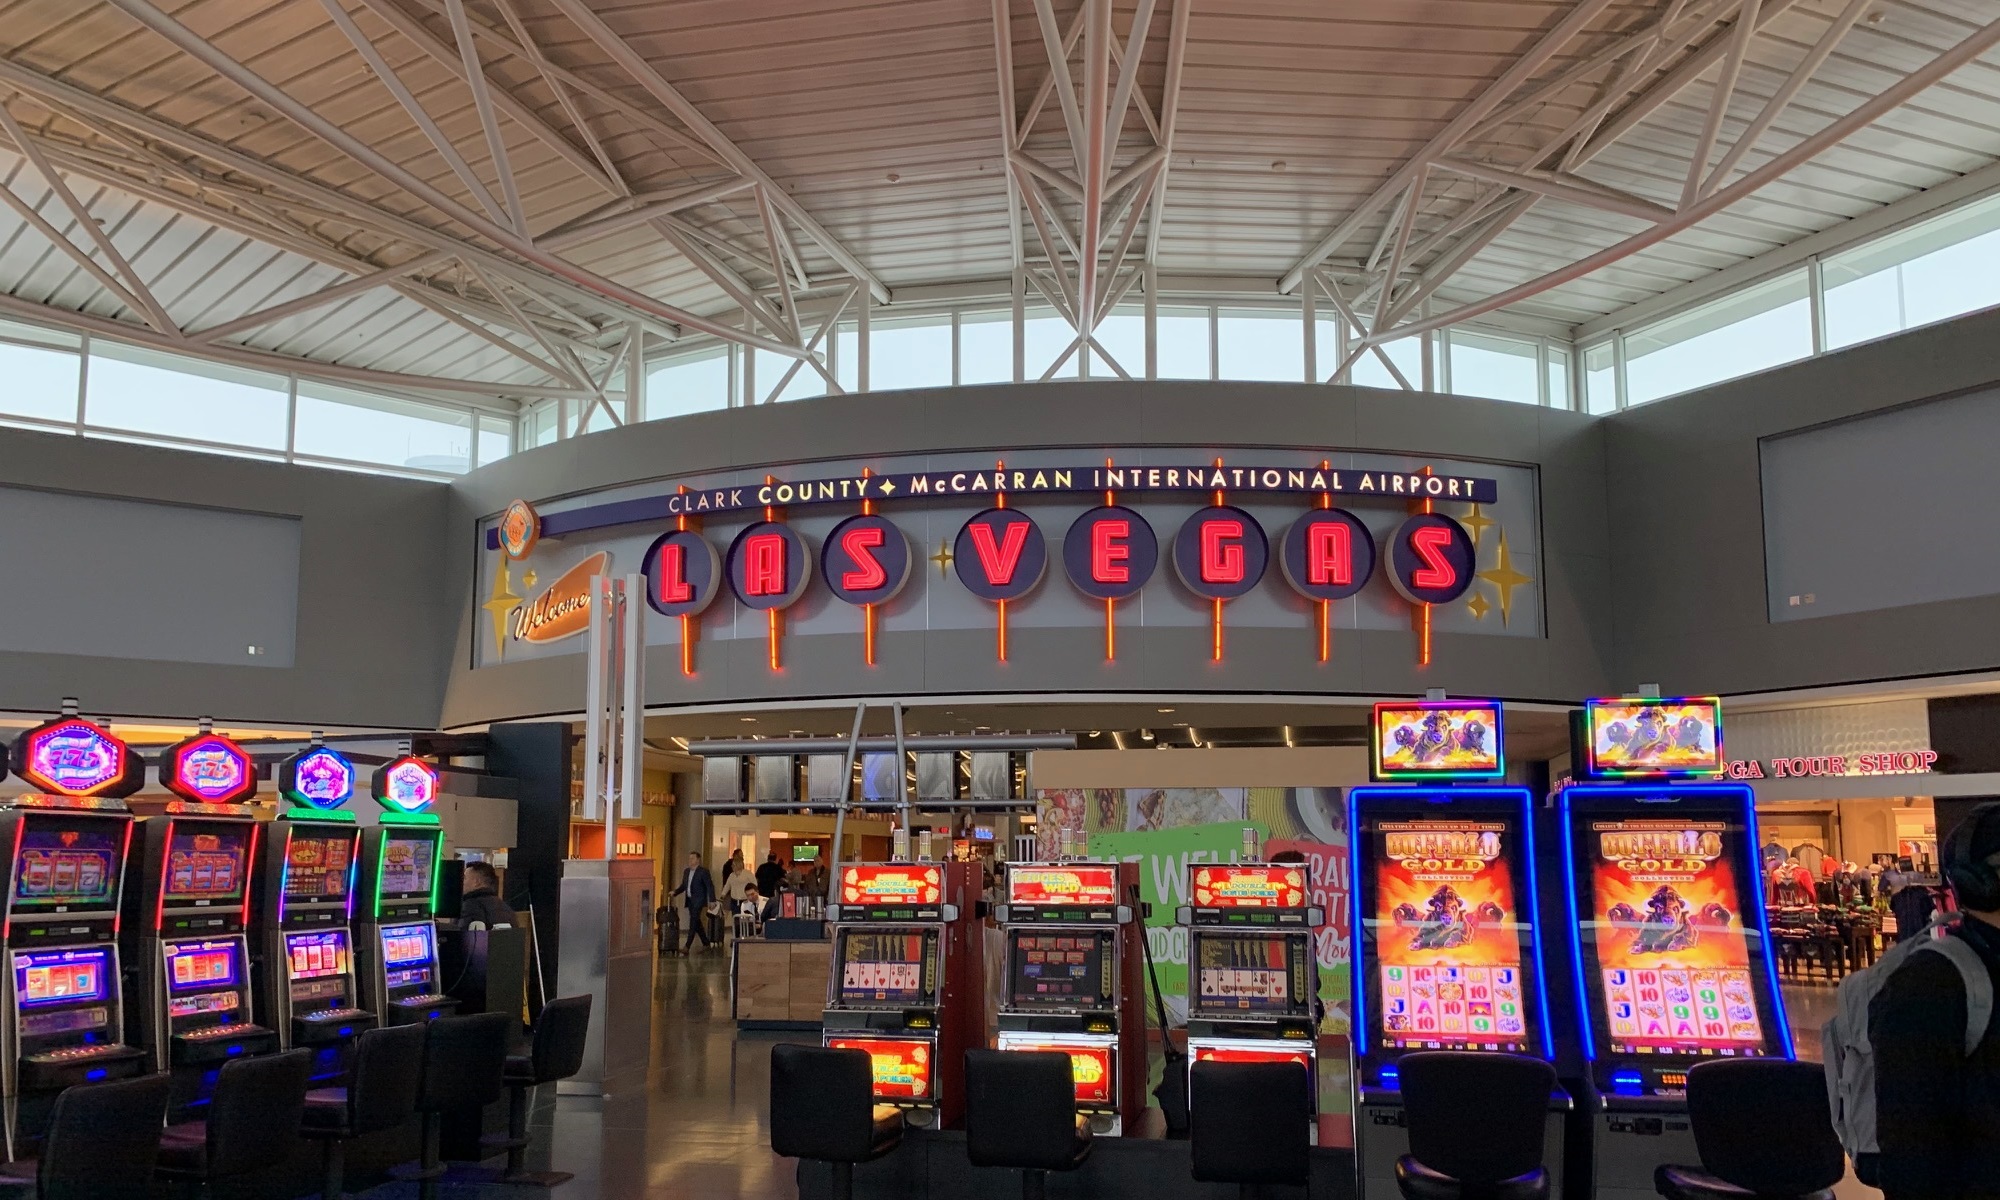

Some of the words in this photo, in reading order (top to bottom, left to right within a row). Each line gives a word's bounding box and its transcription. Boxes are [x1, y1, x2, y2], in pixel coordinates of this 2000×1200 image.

[669, 490, 743, 513] CLARK
[758, 479, 868, 504] COUNTY
[910, 470, 1072, 494] McCARRAN
[1095, 469, 1343, 489] INTERNATIONAL
[1359, 474, 1476, 497] AIRPORT
[661, 528, 886, 603] LAS
[969, 520, 1456, 588] VEGAS
[511, 587, 592, 641] Welcome
[1772, 756, 1845, 777] TOUR
[1859, 750, 1938, 773] SHOP
[1386, 832, 1501, 859] BUFFALO
[1601, 831, 1722, 859] BUFFALO
[1401, 859, 1486, 871] GOLD
[1617, 860, 1706, 873] GOLD
[1015, 873, 1065, 882] DEUCES
[1046, 883, 1079, 893] WILD
[1388, 967, 1403, 982] 9
[1414, 968, 1431, 982] 10
[1442, 967, 1458, 983] J
[1497, 969, 1513, 984] J
[1609, 969, 1626, 985] J
[1637, 971, 1656, 985] 10
[1470, 986, 1487, 999] 10
[1612, 988, 1630, 1002] K
[1640, 988, 1658, 1002] 10
[1700, 989, 1716, 1003] 9
[1389, 999, 1405, 1014] J
[1417, 1000, 1434, 1014] A
[1444, 1001, 1461, 1015] 10
[1501, 1002, 1516, 1016] 9
[1614, 1003, 1631, 1018] J
[1674, 1005, 1689, 1019] 9
[1703, 1006, 1719, 1020] 9
[1417, 1016, 1434, 1030] 10
[1474, 1017, 1489, 1032] 9
[1647, 1021, 1664, 1035] A
[1677, 1021, 1694, 1036] A
[1705, 1023, 1724, 1036] 10
